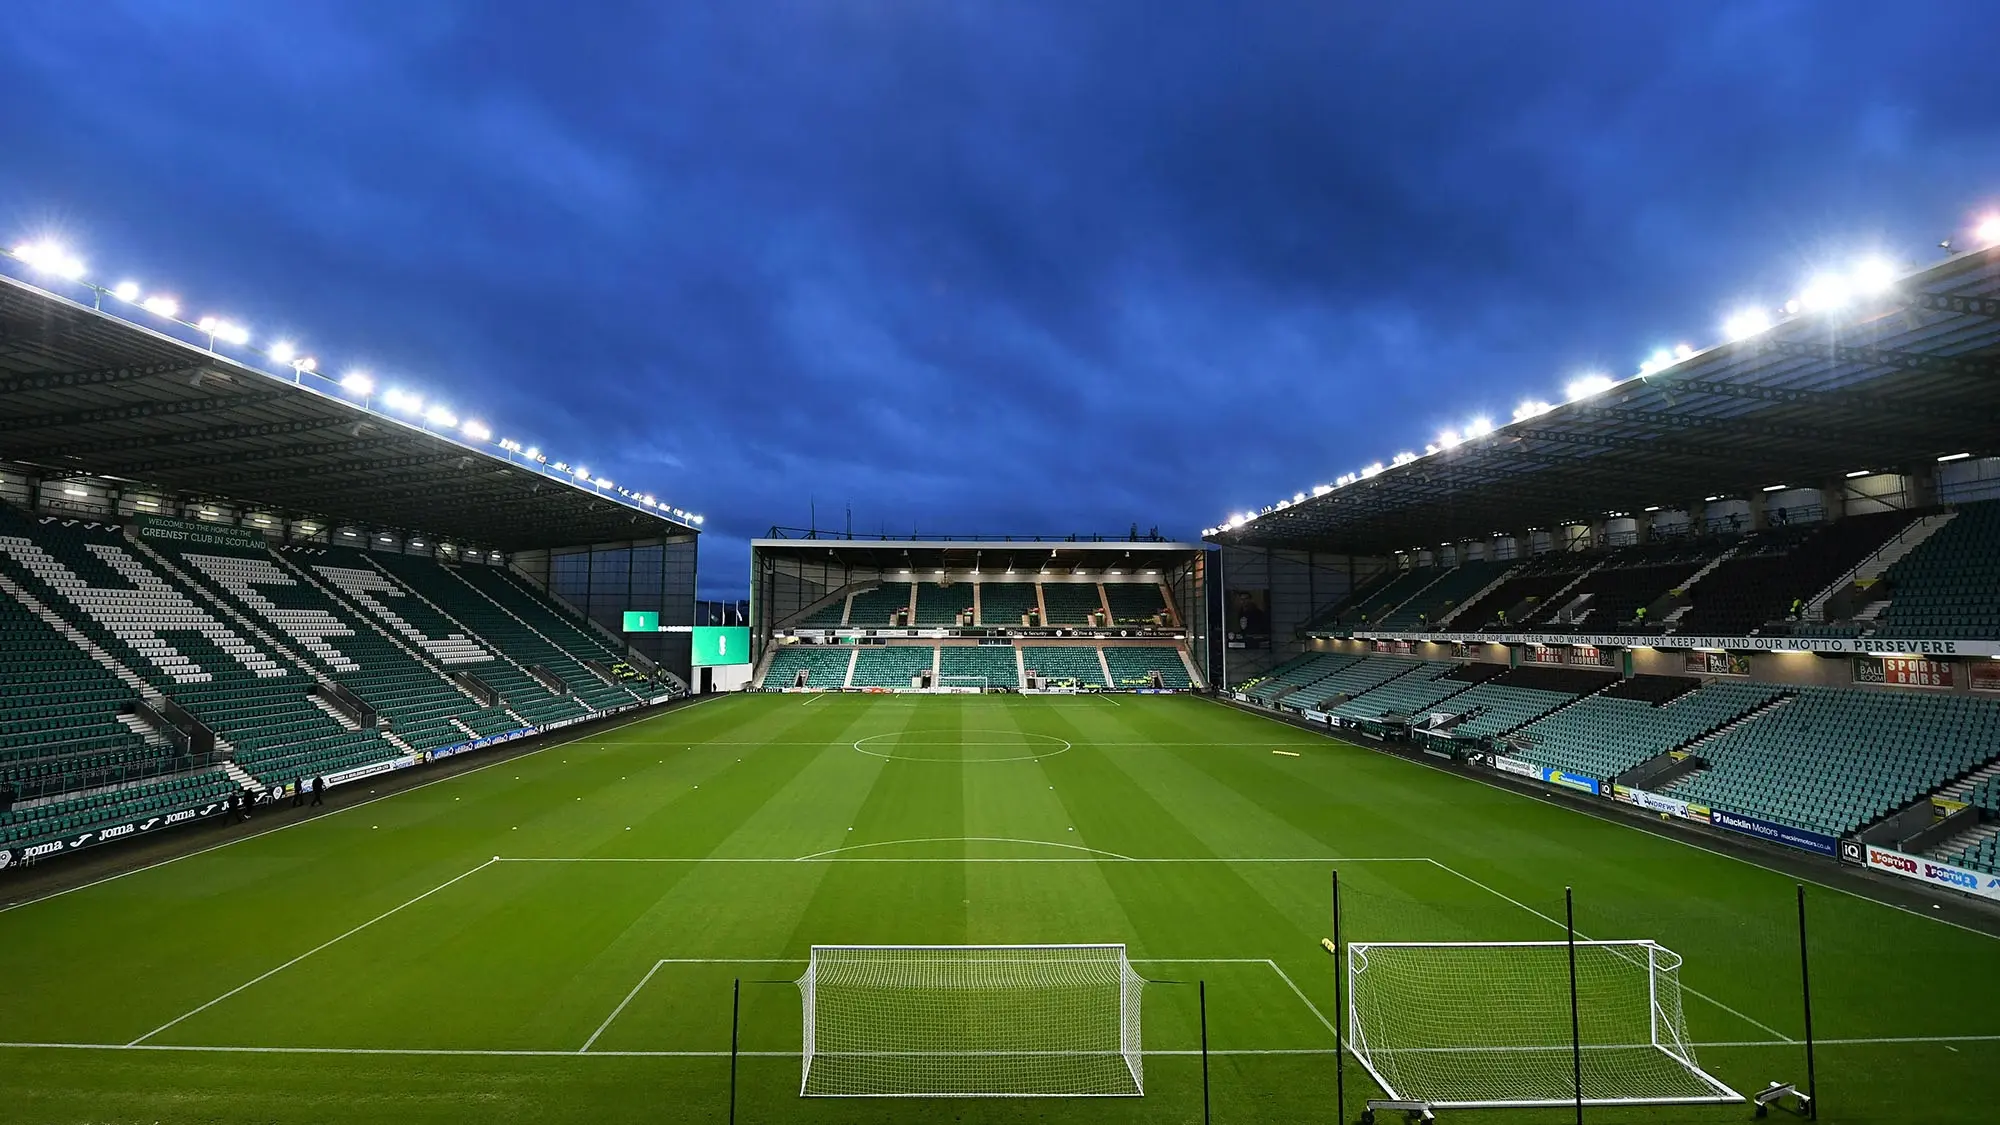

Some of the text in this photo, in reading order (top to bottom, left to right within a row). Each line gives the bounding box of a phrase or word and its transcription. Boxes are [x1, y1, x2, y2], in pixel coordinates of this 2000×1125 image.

[148, 517, 183, 529] WELCOME
[196, 524, 209, 532] THE
[210, 527, 229, 535] HOME
[239, 530, 251, 538] THE
[142, 527, 266, 549] GREENEST CLUB IN SCOTLAND
[1463, 634, 1476, 642] SHIP
[1478, 634, 1486, 642] OF
[1486, 634, 1503, 642] HOPE
[1505, 634, 1521, 642] WILL
[1548, 635, 1566, 643] AND
[1567, 636, 1592, 644] WHEN
[1593, 636, 1604, 645] IN
[1607, 637, 1638, 646] DOUBT
[1641, 637, 1666, 646] JUST
[1670, 638, 1696, 647] KEEP
[1700, 638, 1712, 648] IN
[1717, 638, 1750, 648] MIND
[1754, 639, 1783, 649] OUR
[1788, 639, 1847, 652] MOTTO,
[1853, 640, 1956, 653] PERSEVERE
[1710, 659, 1728, 667] BALL
[1860, 665, 1884, 675] BALL
[1887, 659, 1949, 673] SPORTS
[1860, 674, 1884, 682] ROOM
[1897, 672, 1941, 685] BARS
[1722, 815, 1832, 851] Macklin Motors macklinmotors.co.uk
[1844, 844, 1859, 858] iQ
[1877, 854, 1912, 868] FORTH 1
[1931, 868, 1971, 884] FORTH 2
